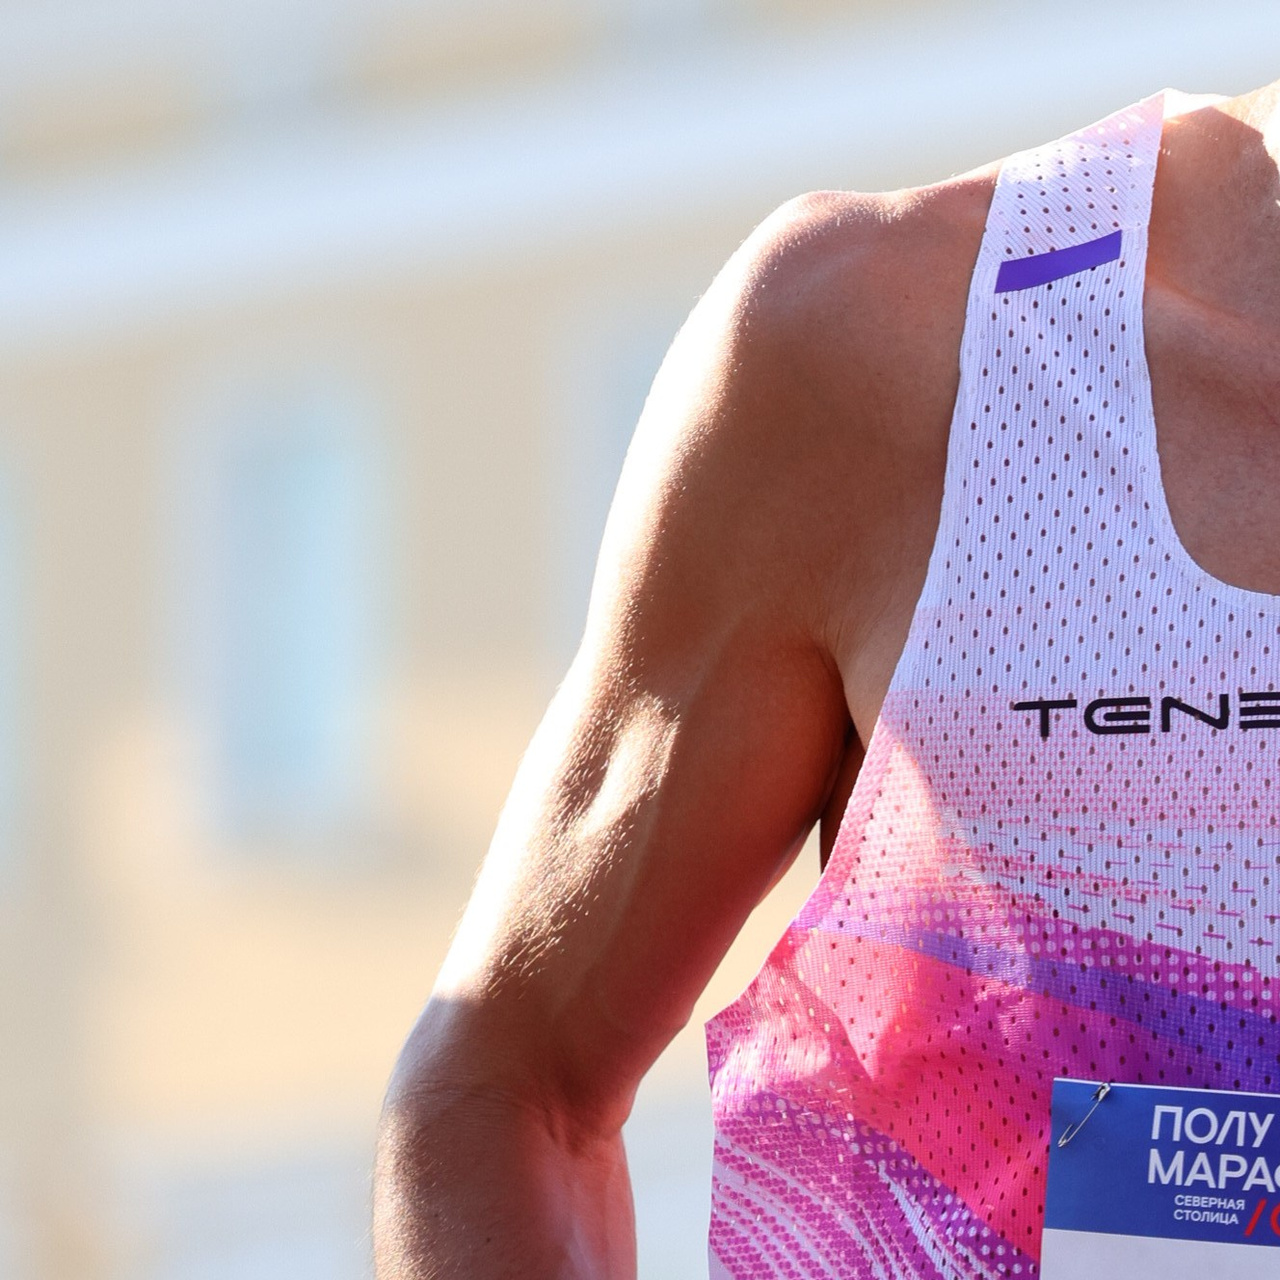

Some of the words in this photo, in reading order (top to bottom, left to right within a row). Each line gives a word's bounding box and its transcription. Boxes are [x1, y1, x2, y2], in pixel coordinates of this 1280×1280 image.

[1151, 1105, 1275, 1148] ПОЛУ
[1174, 1194, 1245, 1211] СЕВЕРНАЯ
[1173, 1209, 1239, 1226] СТОЛИЦА
